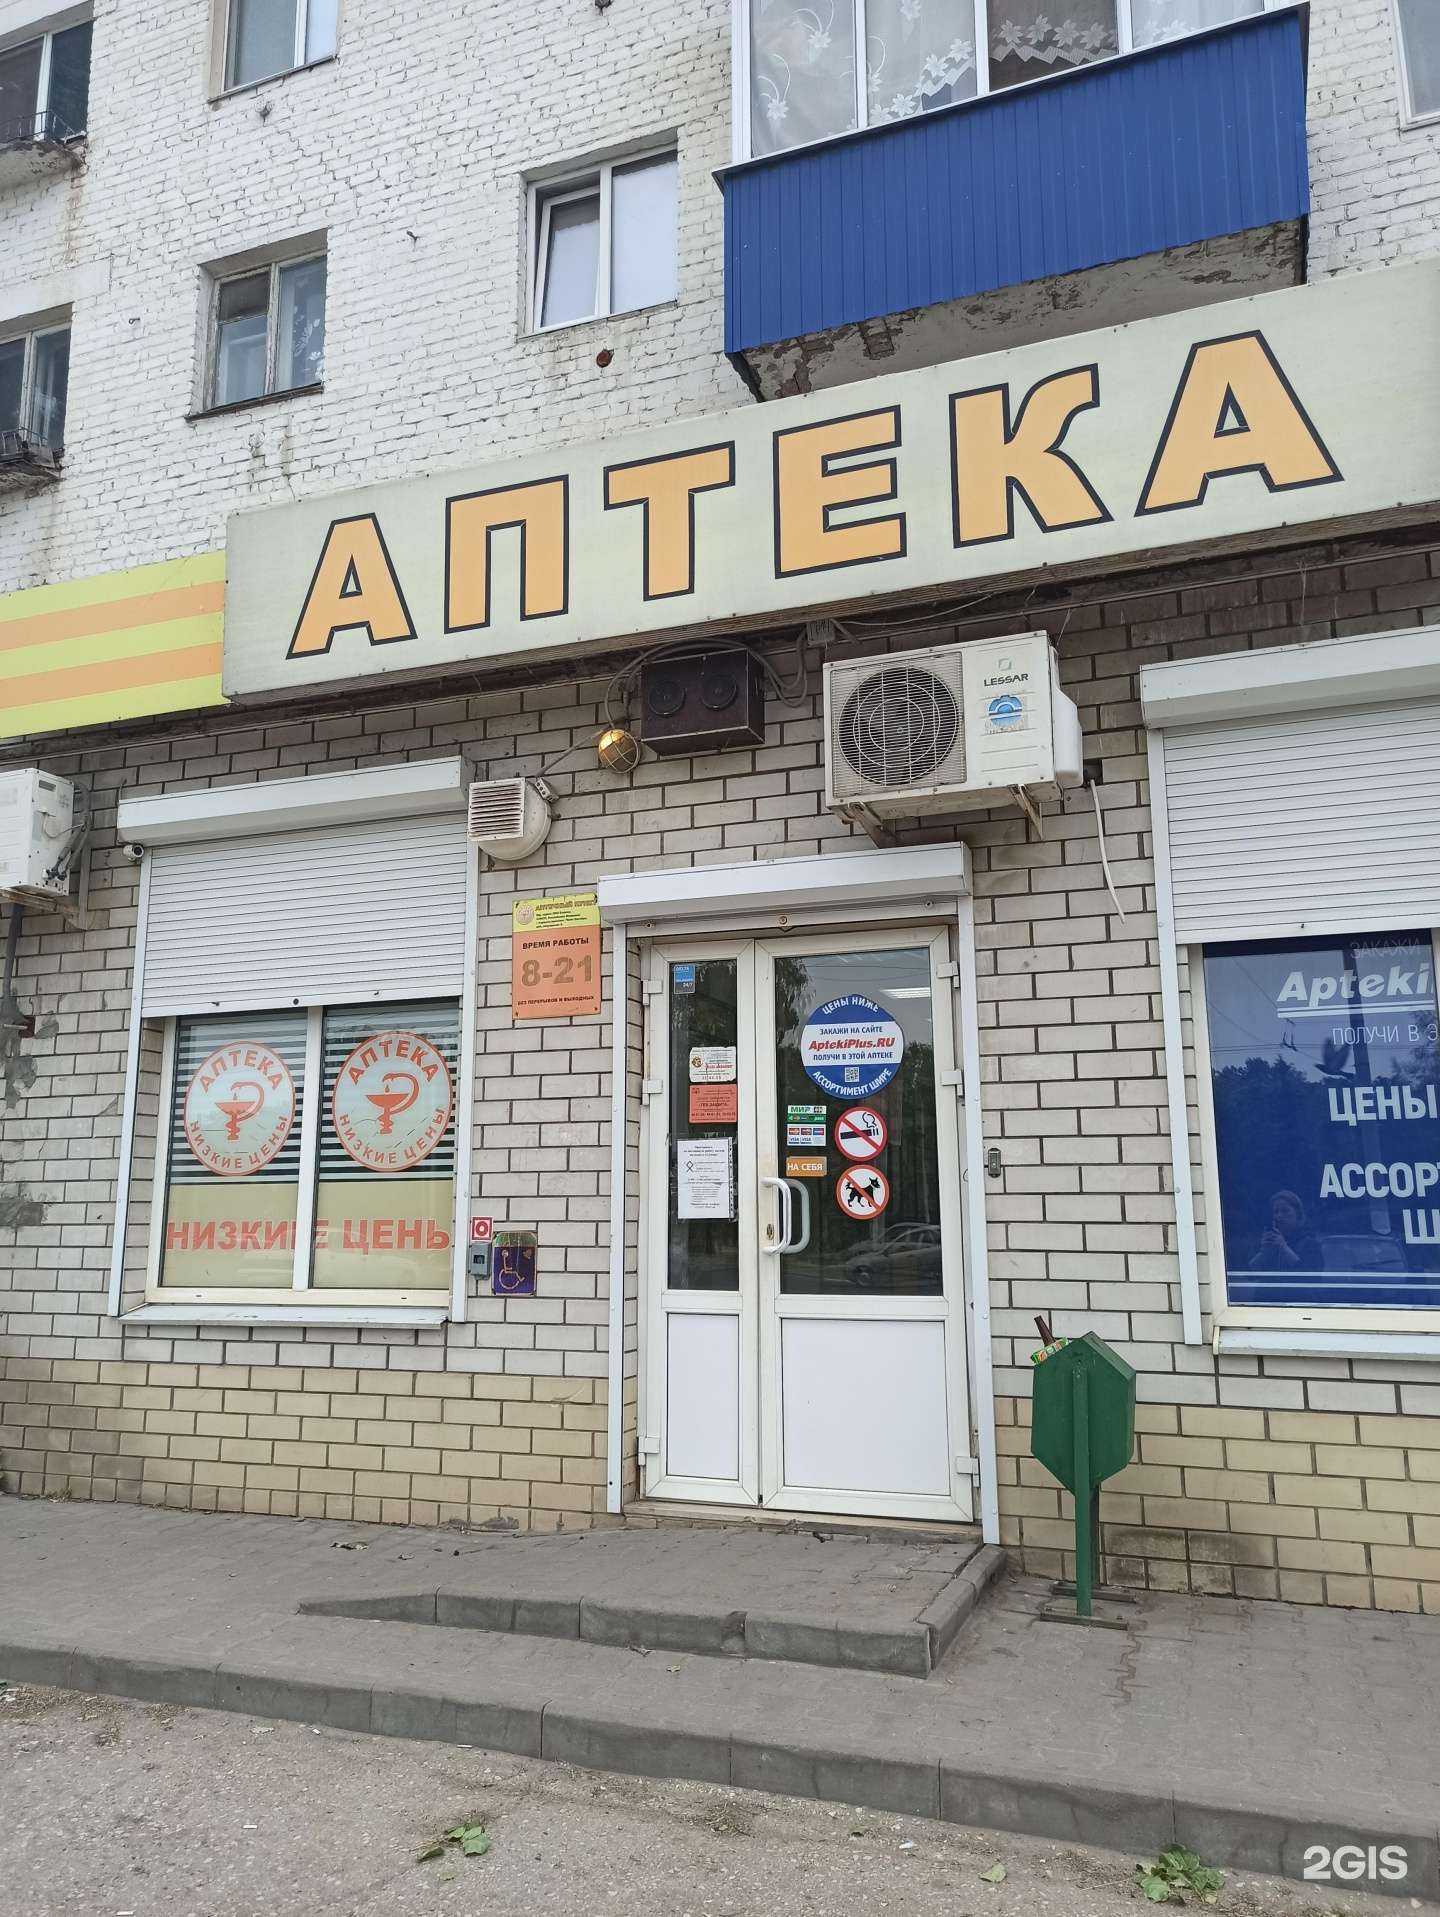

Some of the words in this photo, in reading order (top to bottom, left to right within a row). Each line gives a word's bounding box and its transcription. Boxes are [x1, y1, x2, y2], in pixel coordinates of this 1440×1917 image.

[286, 329, 1344, 660] АПТЕКА
[984, 673, 1029, 687] LESSAR
[522, 940, 551, 950] ВРЕМЯ
[552, 937, 589, 948] РАБОТЫ
[1350, 937, 1421, 959] ЗАКАЖИ
[521, 955, 592, 987] 8-21
[1277, 962, 1434, 1008] Apteki
[822, 998, 849, 1015] ЦЕНЫ
[852, 997, 879, 1013] НИЖЕ
[808, 1037, 896, 1052] AptekiPlus.RU
[820, 1027, 849, 1036] ЗАКАЖИ
[850, 1027, 860, 1035] НА
[861, 1025, 883, 1034] САЙТЕ
[1332, 1025, 1400, 1045] ПОЛУЧИ
[1408, 1024, 1420, 1042] В
[348, 1039, 439, 1085] АПТЕКА
[813, 1053, 841, 1061] ПОЛУЧИ
[848, 1051, 866, 1060] ЭТОЙ
[867, 1051, 894, 1060] АПТЕКЕ
[200, 1049, 283, 1093] АПТЕКА
[812, 1071, 868, 1096] АССОРТИМЕНТ
[869, 1068, 892, 1091] ШИРЕ
[1328, 1084, 1438, 1127] ЦЕНЫ
[190, 1120, 243, 1169] НИЗКИЕ
[250, 1115, 288, 1166] ЦЕНЫ
[340, 1113, 397, 1164] НИЗКИЕ
[405, 1107, 446, 1160] ЦЕНЫ
[787, 1163, 800, 1171] НА
[801, 1163, 823, 1171] СЕБЯ
[1319, 1161, 1440, 1199] АССОР
